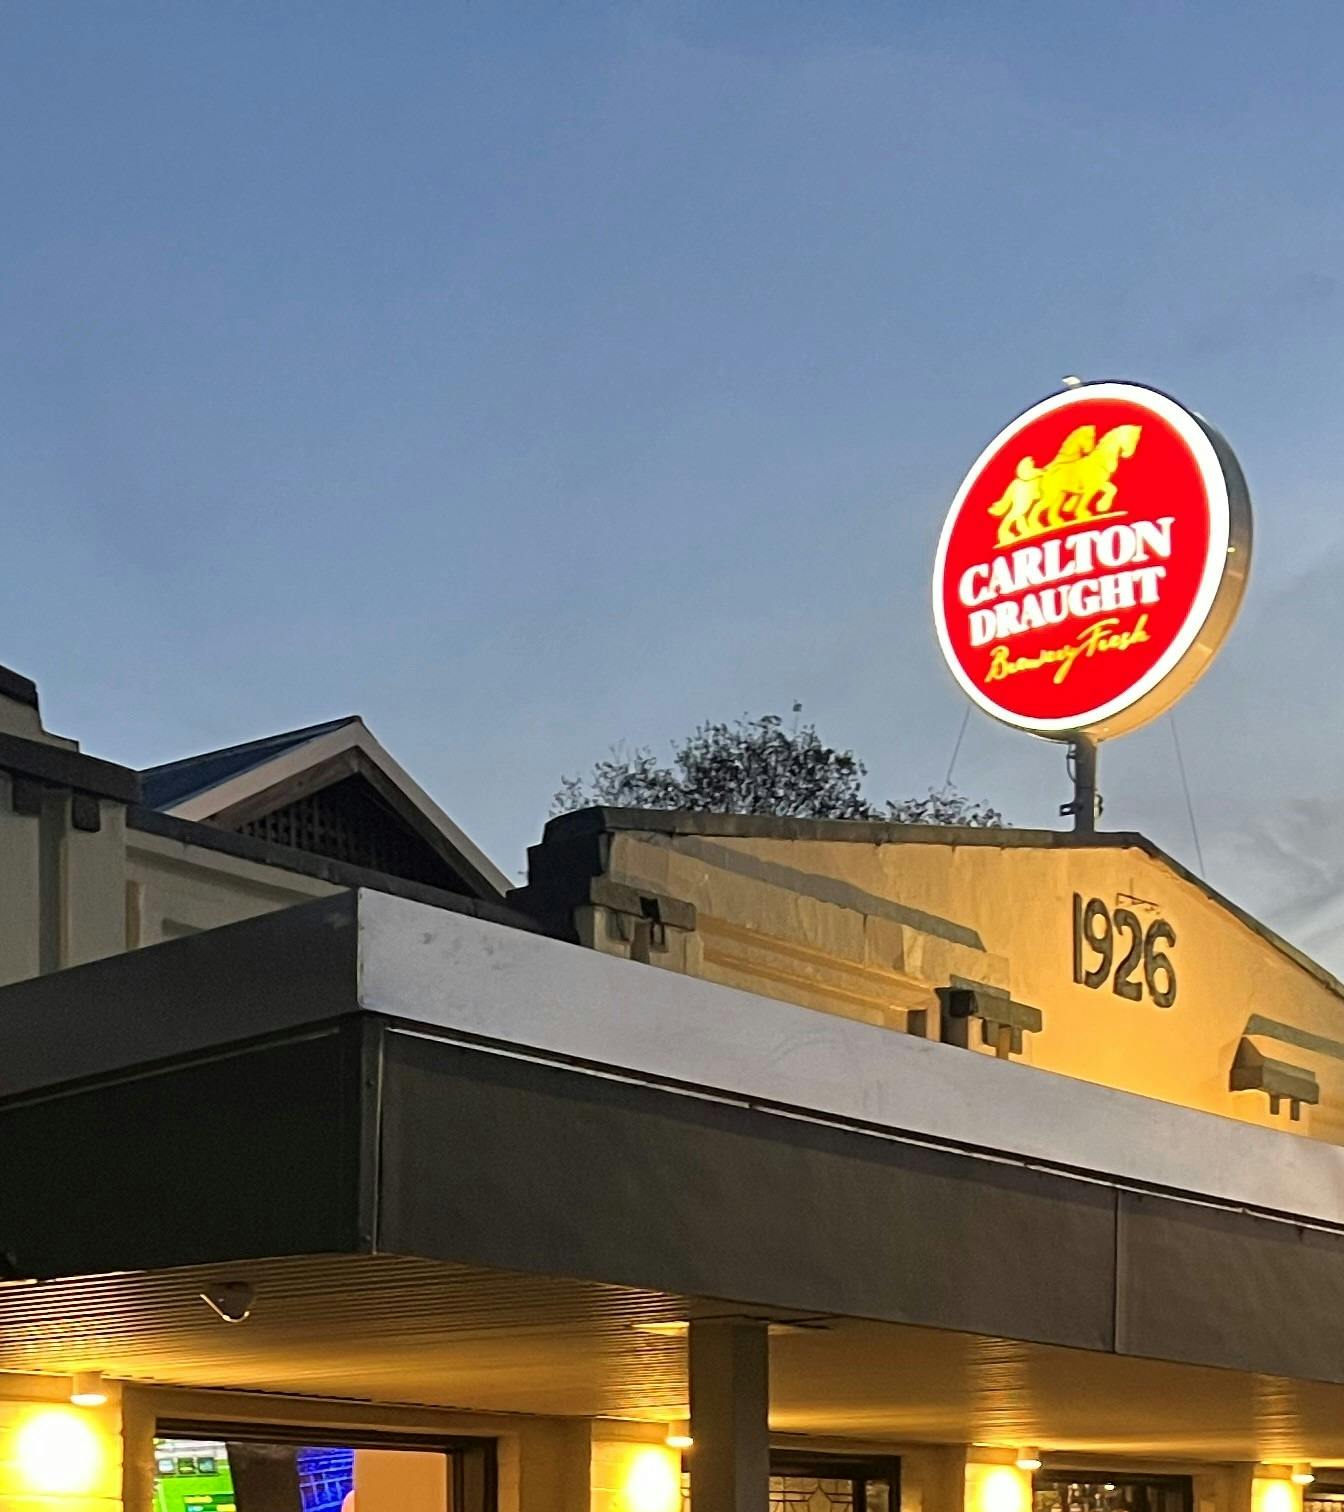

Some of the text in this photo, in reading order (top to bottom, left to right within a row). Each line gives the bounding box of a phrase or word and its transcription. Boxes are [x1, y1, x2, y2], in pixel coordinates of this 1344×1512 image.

[958, 517, 1175, 607] CARLTON
[968, 565, 1166, 647] DRAUGHT
[1077, 614, 1151, 656] Fresh
[1073, 891, 1176, 1008] 1926
